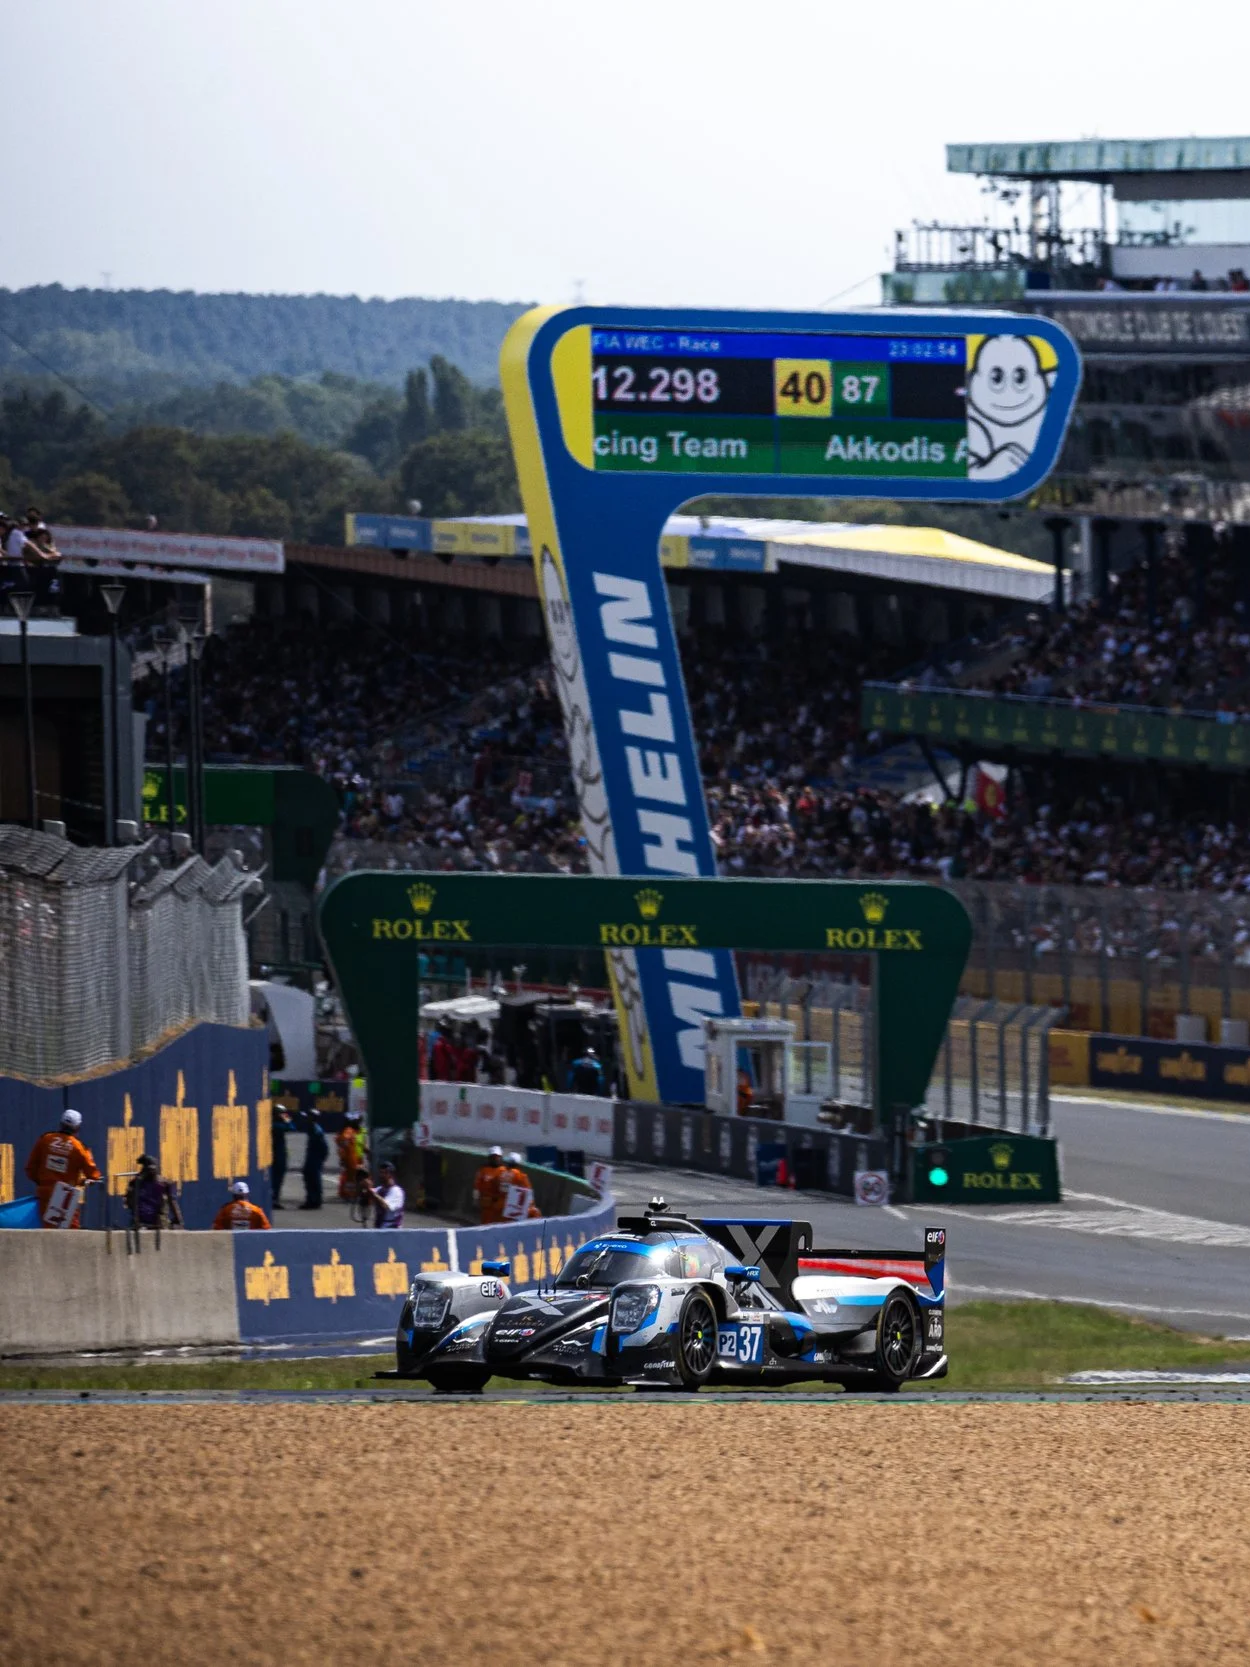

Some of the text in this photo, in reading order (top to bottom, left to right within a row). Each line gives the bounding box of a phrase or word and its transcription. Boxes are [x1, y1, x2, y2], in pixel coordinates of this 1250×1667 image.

[679, 335, 720, 352] Race
[592, 365, 721, 403] 12.298
[780, 371, 827, 405] 40
[841, 375, 880, 404] 87
[593, 430, 748, 463] cing Team
[824, 435, 946, 463] Akkodis
[592, 571, 724, 1071] MIHELIN
[371, 918, 472, 942] ROLEX
[600, 923, 697, 945] ROLEX
[826, 928, 922, 951] ROLEX
[963, 1172, 1043, 1190] ROLEX
[927, 1231, 938, 1242] elf
[481, 1282, 496, 1297] elf
[720, 1334, 735, 1352] P2
[739, 1326, 761, 1361] 37
